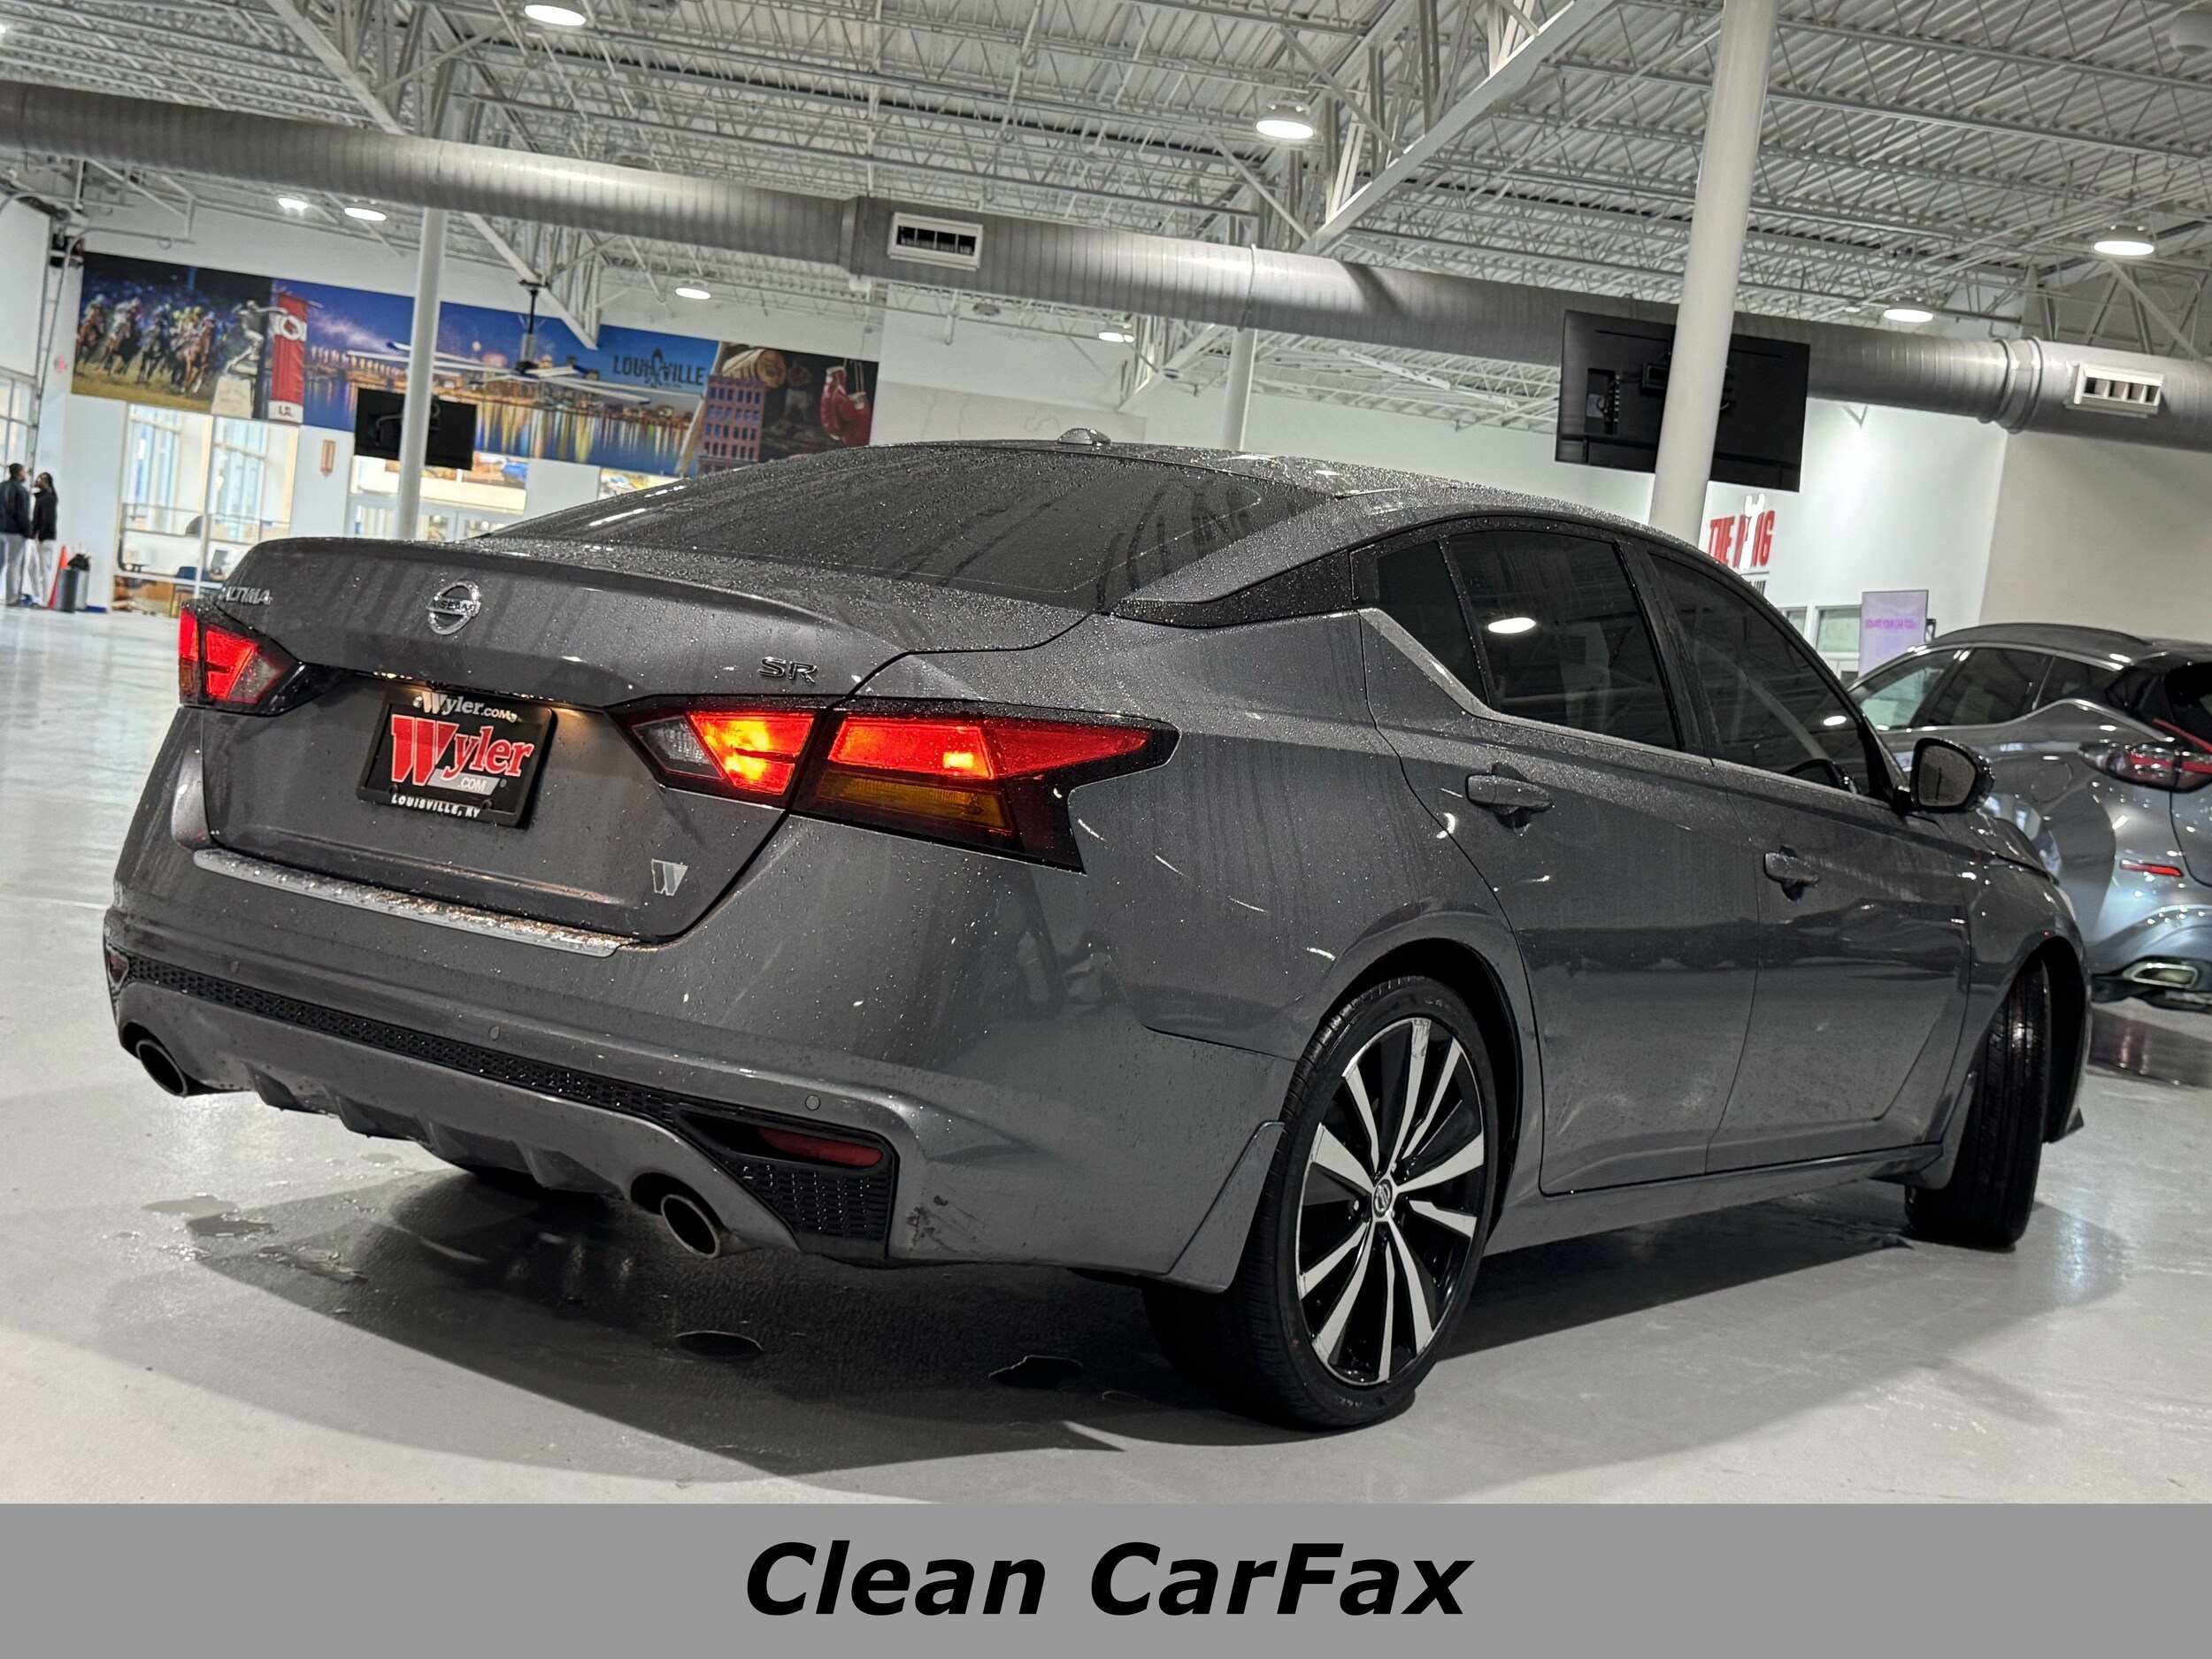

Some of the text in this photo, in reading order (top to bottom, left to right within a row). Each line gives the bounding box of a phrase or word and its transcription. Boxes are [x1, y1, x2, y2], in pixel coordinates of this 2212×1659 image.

[758, 656, 816, 684] SR
[391, 714, 534, 787] Wyler
[391, 794, 481, 818] LOUISVILLE, KY
